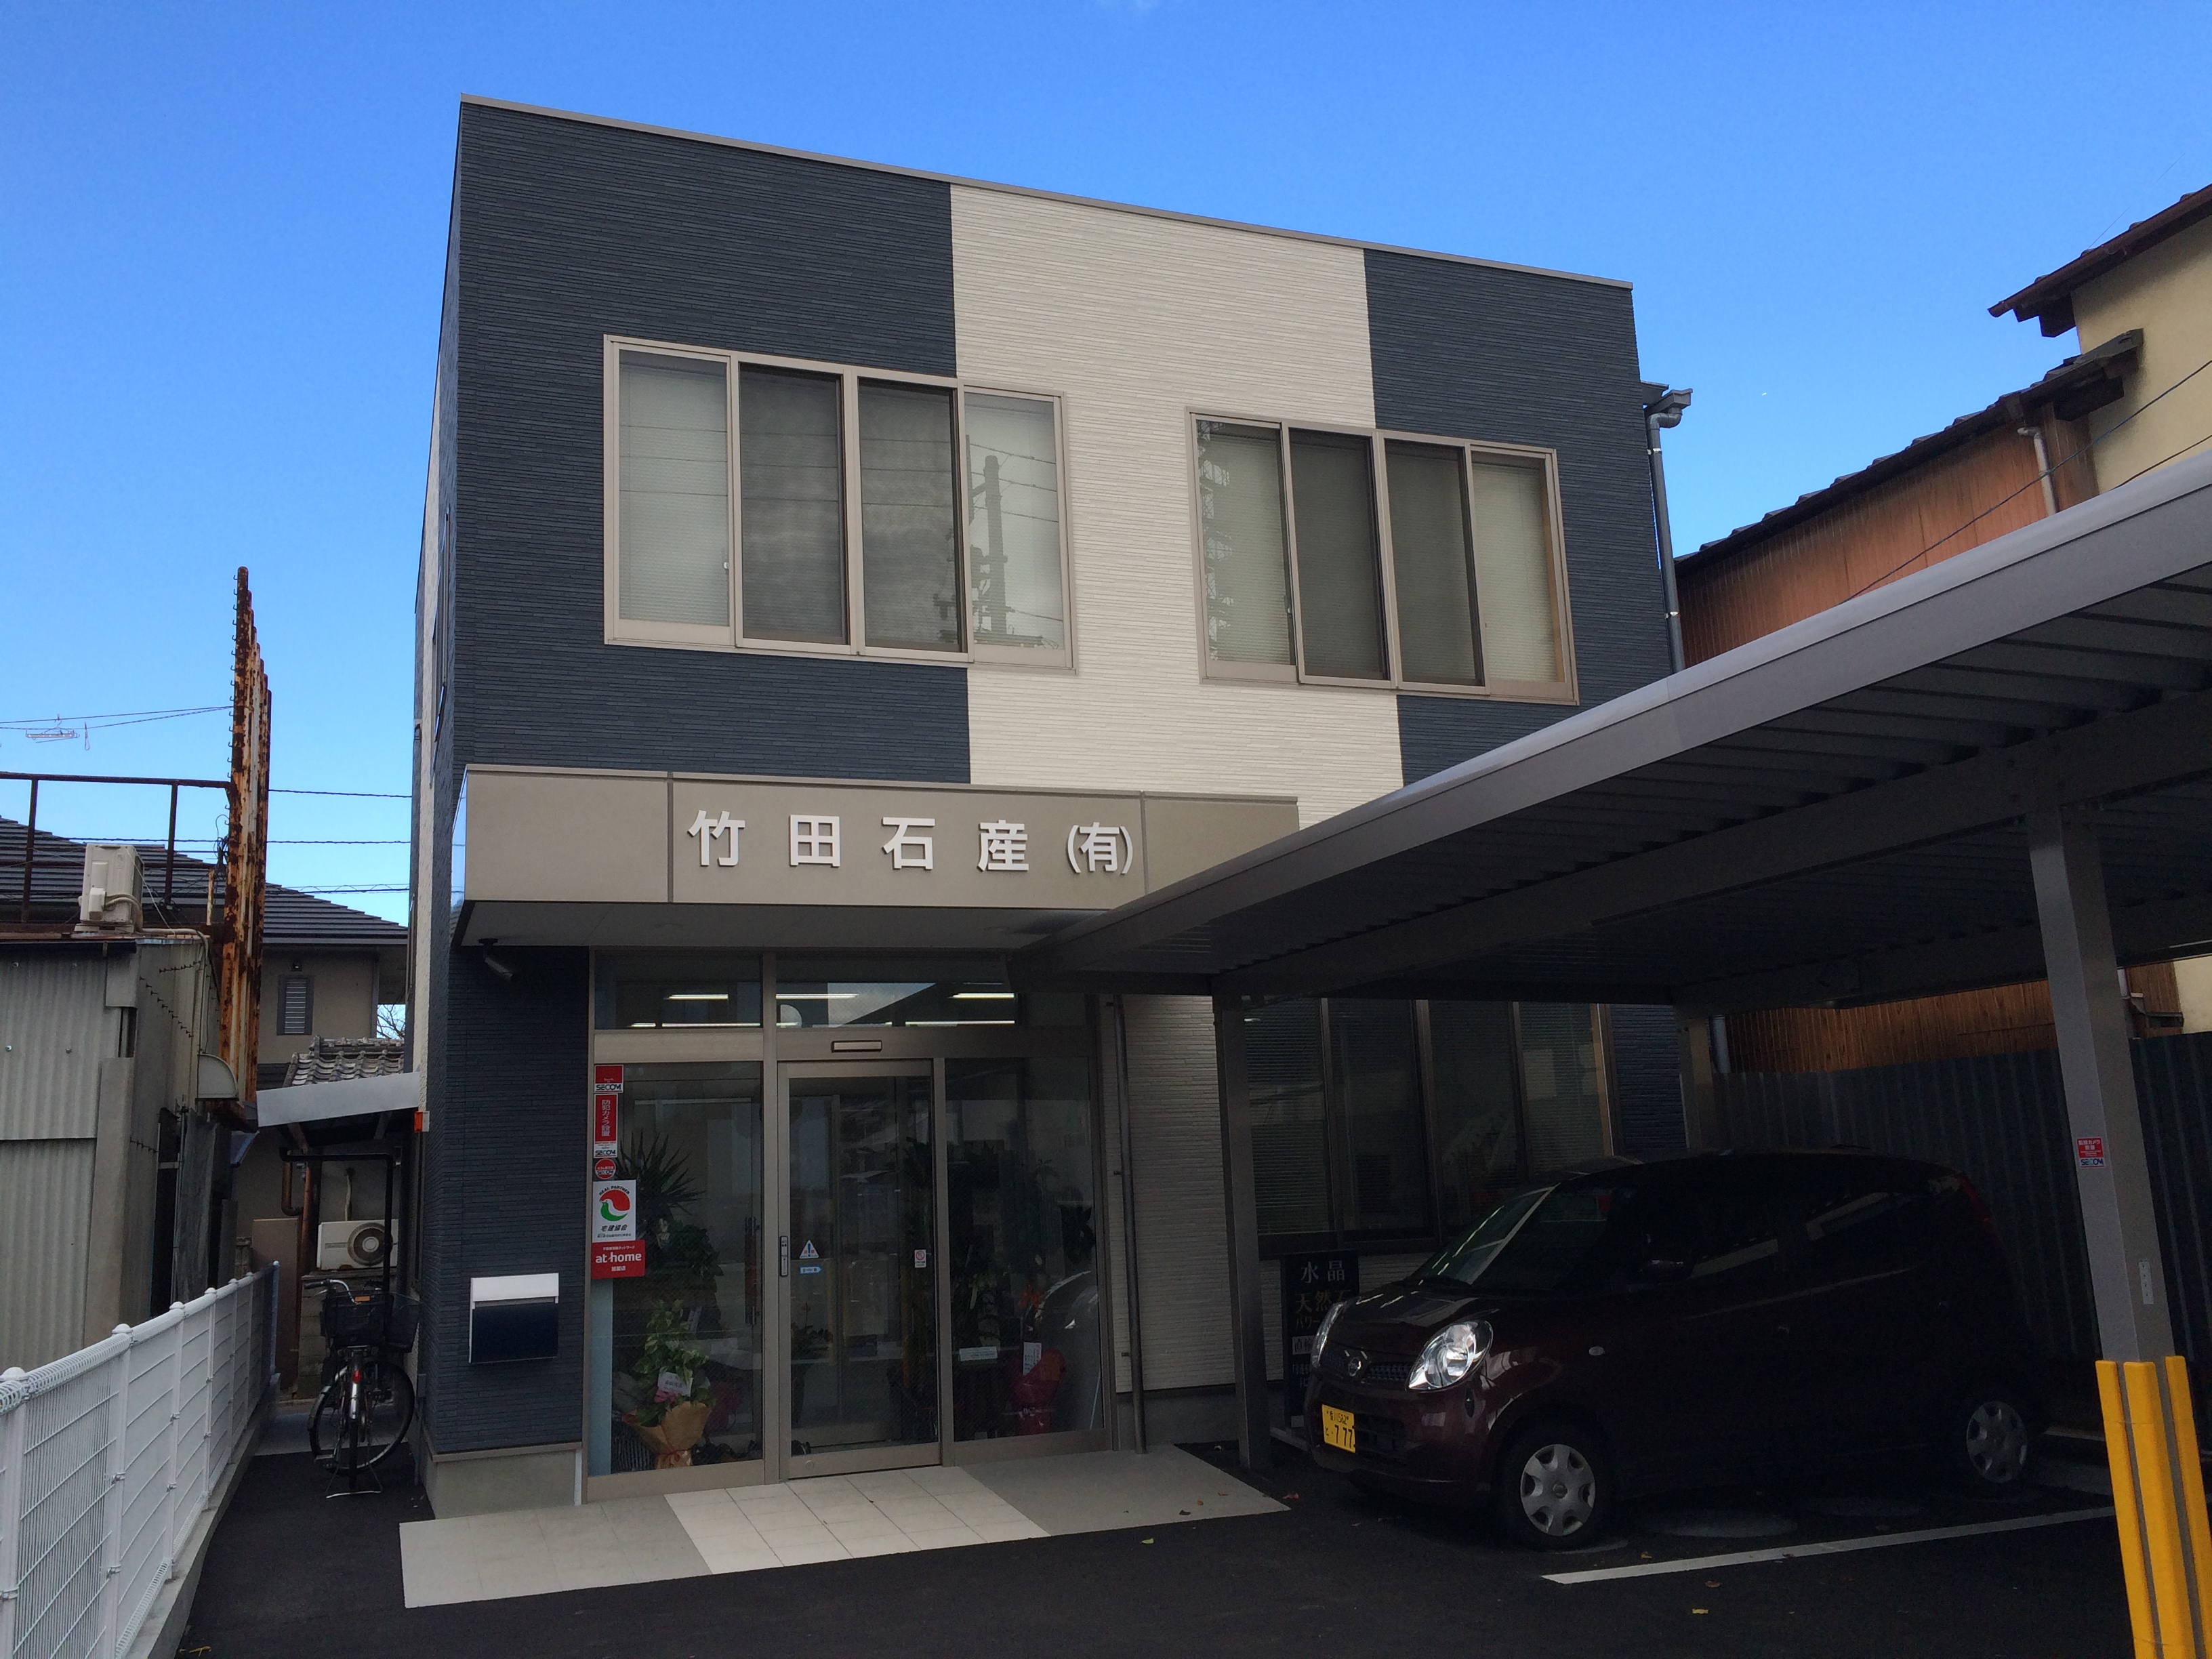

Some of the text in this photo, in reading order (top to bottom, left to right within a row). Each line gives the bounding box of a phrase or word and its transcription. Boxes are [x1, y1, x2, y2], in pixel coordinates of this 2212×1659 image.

[687, 810, 1134, 874] 竹田石産(有)
[598, 1185, 630, 1195] REAL PARTNER
[608, 1252, 642, 1263] home
[1300, 1260, 1345, 1284] 水晶
